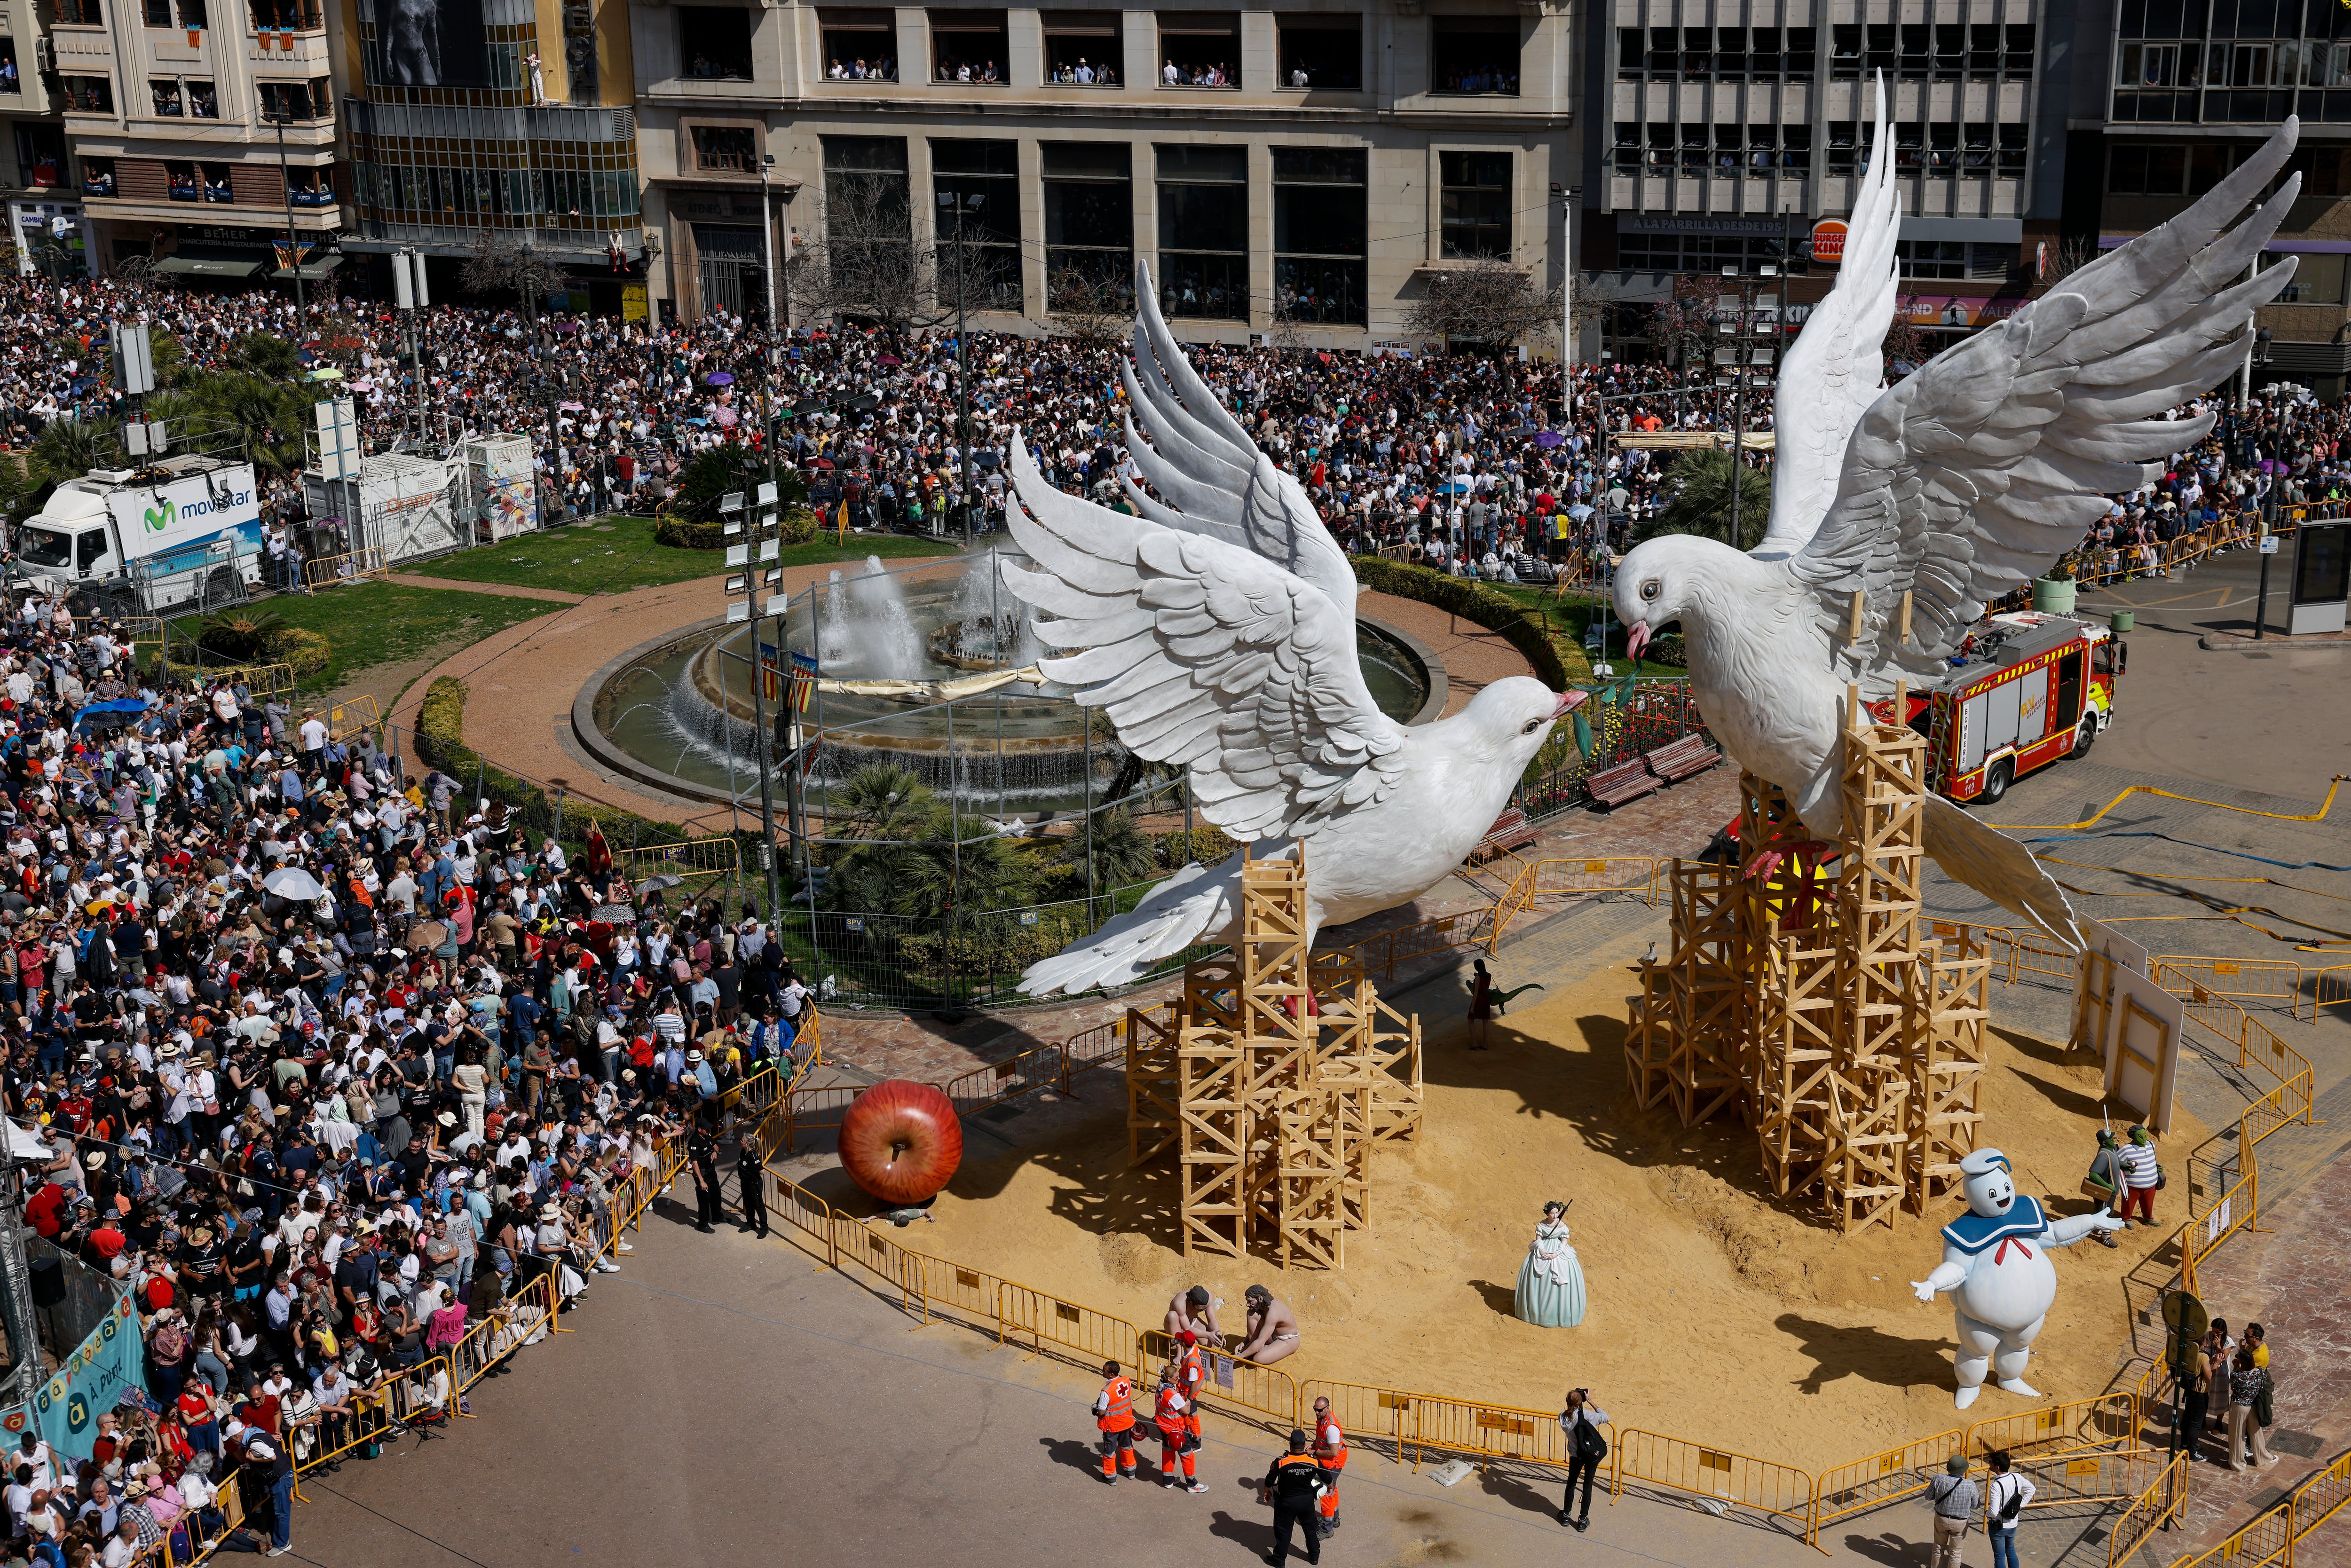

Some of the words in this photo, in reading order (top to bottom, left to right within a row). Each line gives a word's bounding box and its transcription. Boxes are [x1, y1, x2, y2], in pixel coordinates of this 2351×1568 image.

[1633, 219, 1643, 228] A
[1643, 219, 1660, 229] LA
[1661, 220, 1721, 229] PARRILLA
[1722, 221, 1760, 230] DESDE
[205, 229, 246, 239] BEHER
[228, 240, 273, 249] RESTAURANTE
[2027, 695, 2045, 715] BOMBERS
[2023, 742, 2047, 757] www.valencia.es
[1964, 782, 1975, 796] 112
[453, 1220, 468, 1229] NEVER
[104, 1324, 114, 1337] à
[53, 1382, 62, 1396] à
[40, 1395, 48, 1409] à
[69, 1401, 86, 1425] à
[9, 1416, 22, 1428] à
